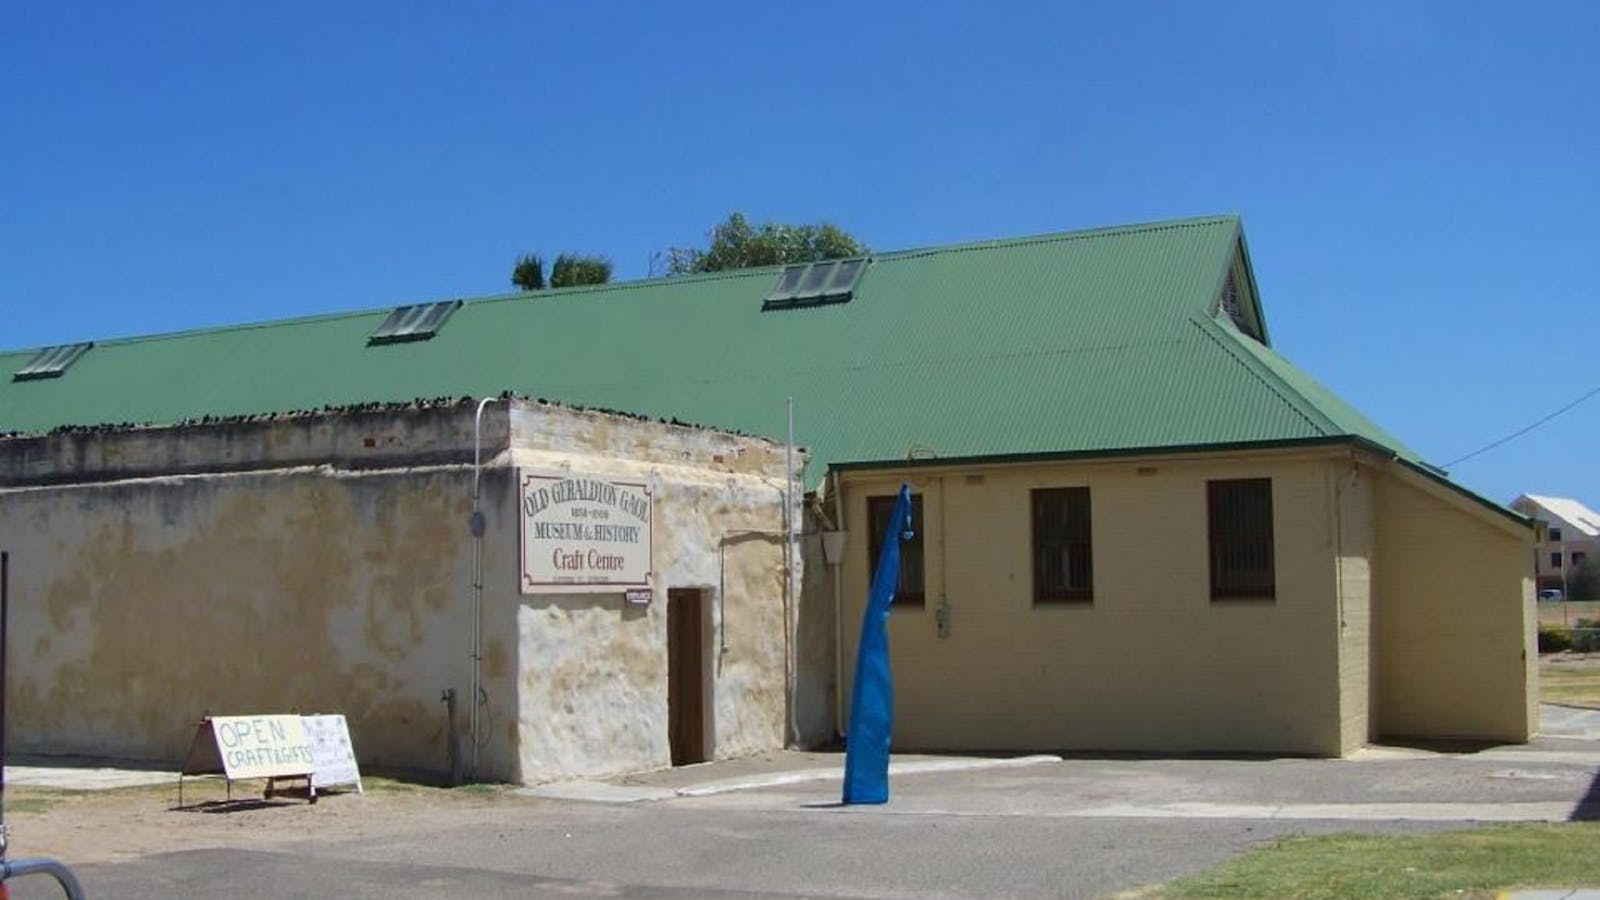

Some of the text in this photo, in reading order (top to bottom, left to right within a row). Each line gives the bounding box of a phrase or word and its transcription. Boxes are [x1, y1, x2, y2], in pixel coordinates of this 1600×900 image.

[524, 487, 549, 517] OLD
[551, 479, 616, 508] GERALDTON
[534, 522, 639, 543] MUSEUM & HISTORY
[552, 547, 624, 571] Craft Centre
[219, 719, 286, 748] OPEN
